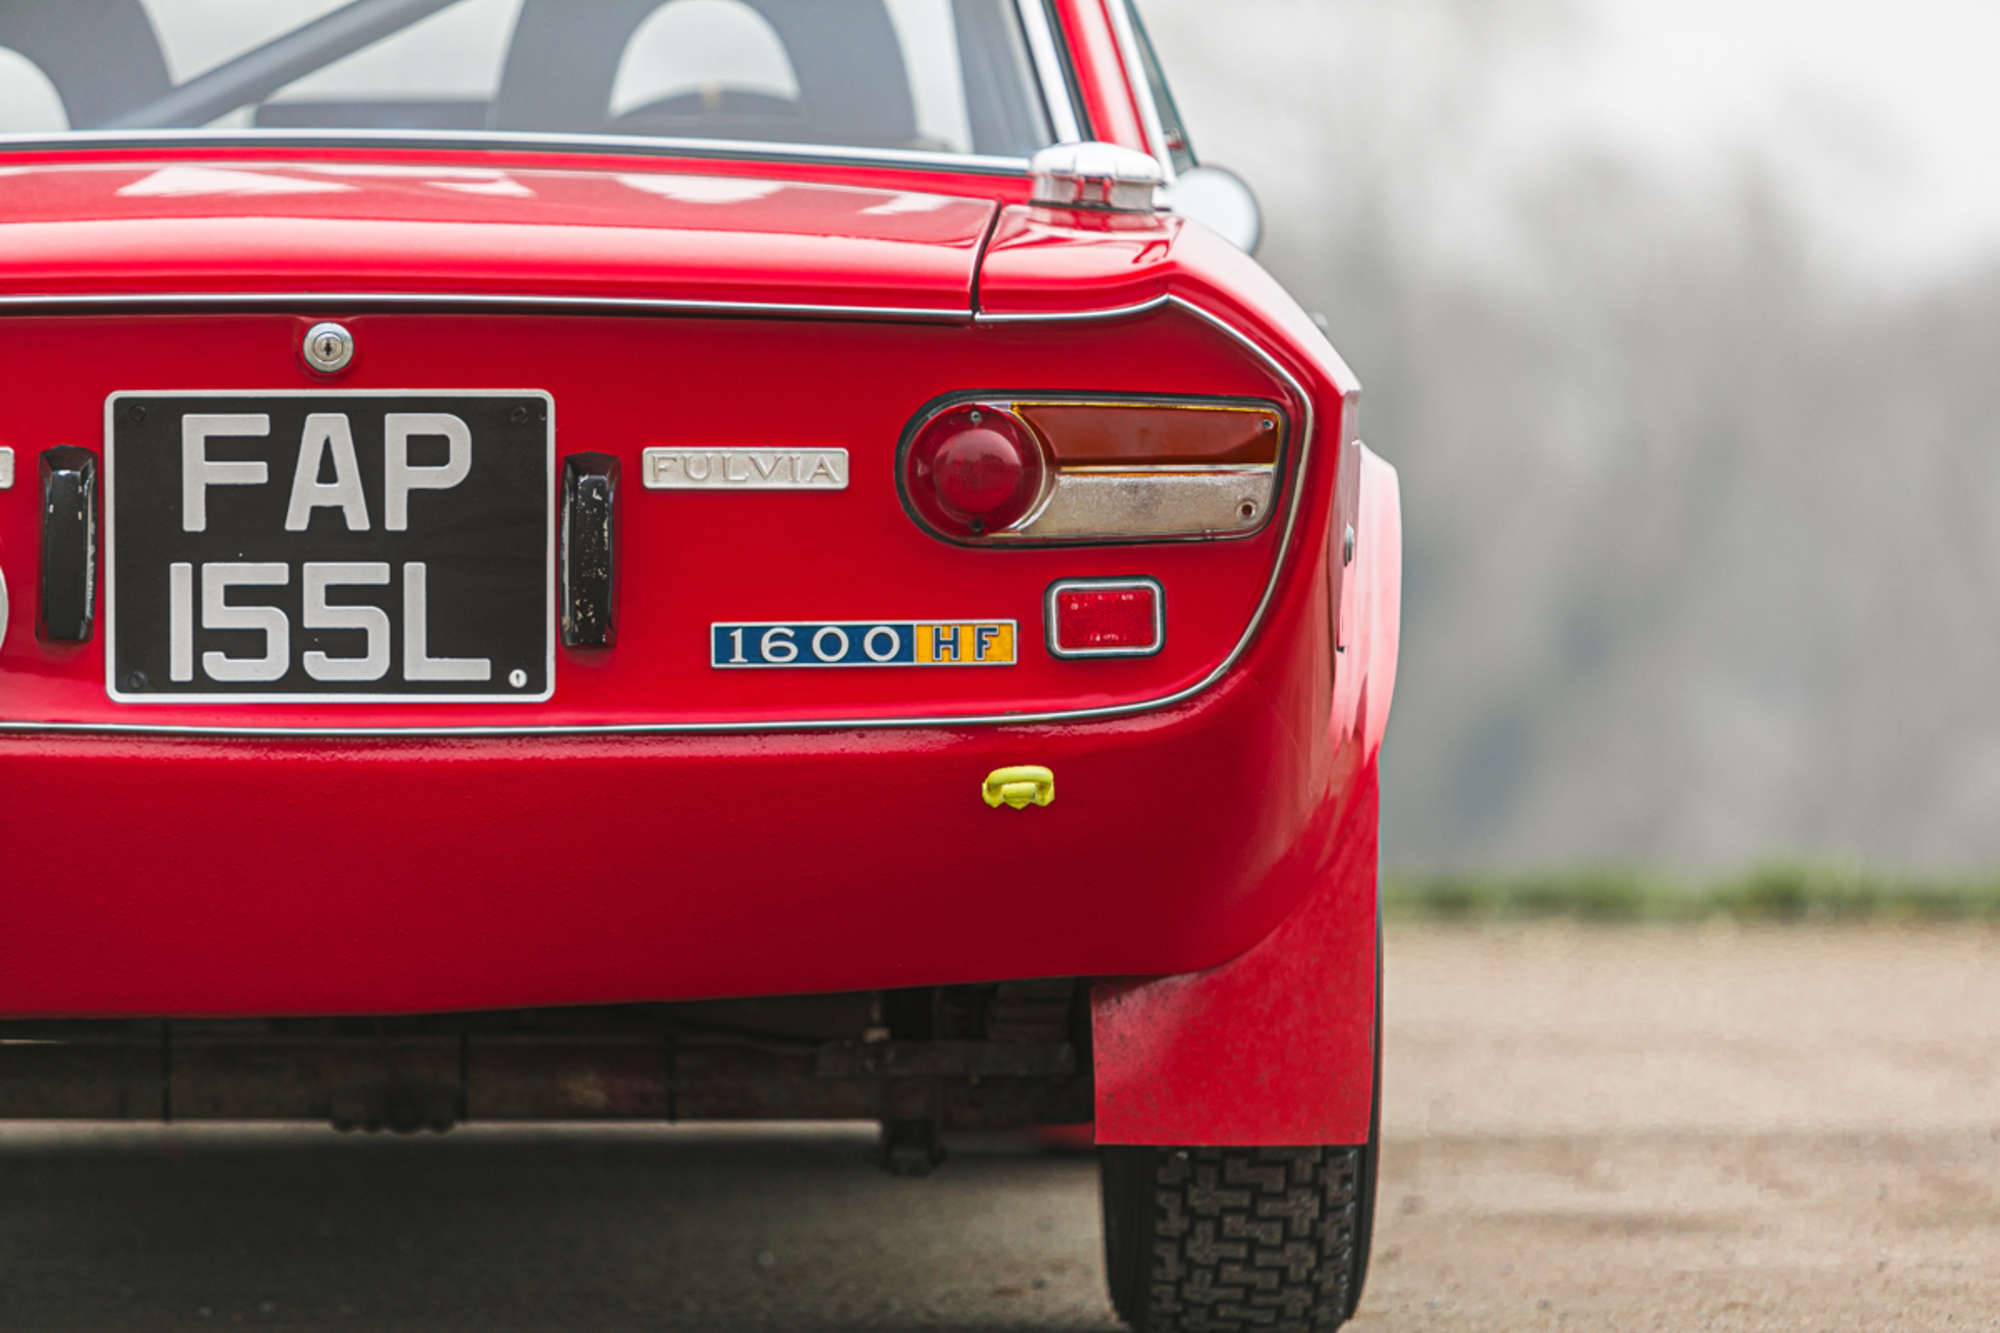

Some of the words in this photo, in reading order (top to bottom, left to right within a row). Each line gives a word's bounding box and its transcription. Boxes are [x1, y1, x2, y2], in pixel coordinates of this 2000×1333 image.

[182, 413, 472, 532] FAP
[651, 455, 841, 483] FULVIA
[170, 562, 492, 681] 155L
[728, 626, 901, 663] 1600
[932, 625, 1000, 661] HF
